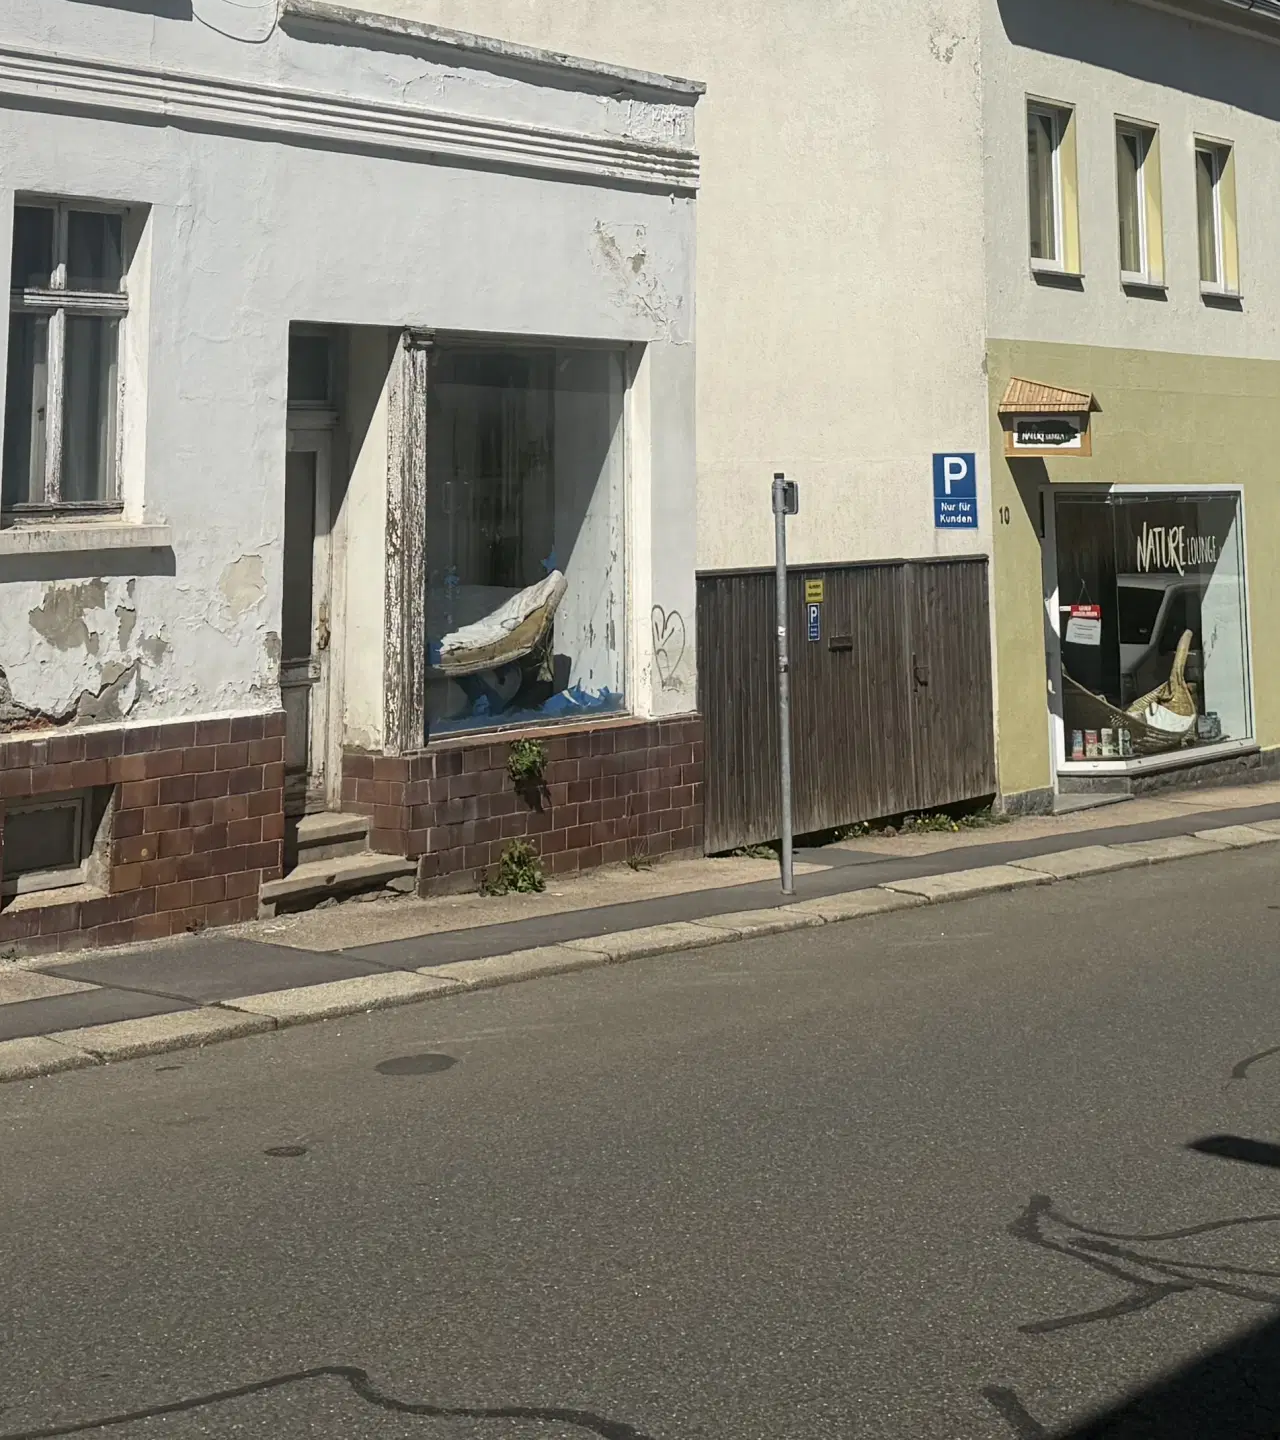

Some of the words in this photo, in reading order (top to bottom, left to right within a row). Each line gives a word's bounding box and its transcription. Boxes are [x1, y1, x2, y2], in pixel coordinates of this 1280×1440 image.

[943, 456, 968, 495] P
[940, 502, 956, 512] Nur
[959, 501, 971, 512] für
[998, 506, 1010, 525] 10
[939, 514, 973, 523] Kunden
[1136, 521, 1186, 577] NATURE
[1186, 535, 1217, 566] LOUNGE
[810, 606, 817, 623] P
